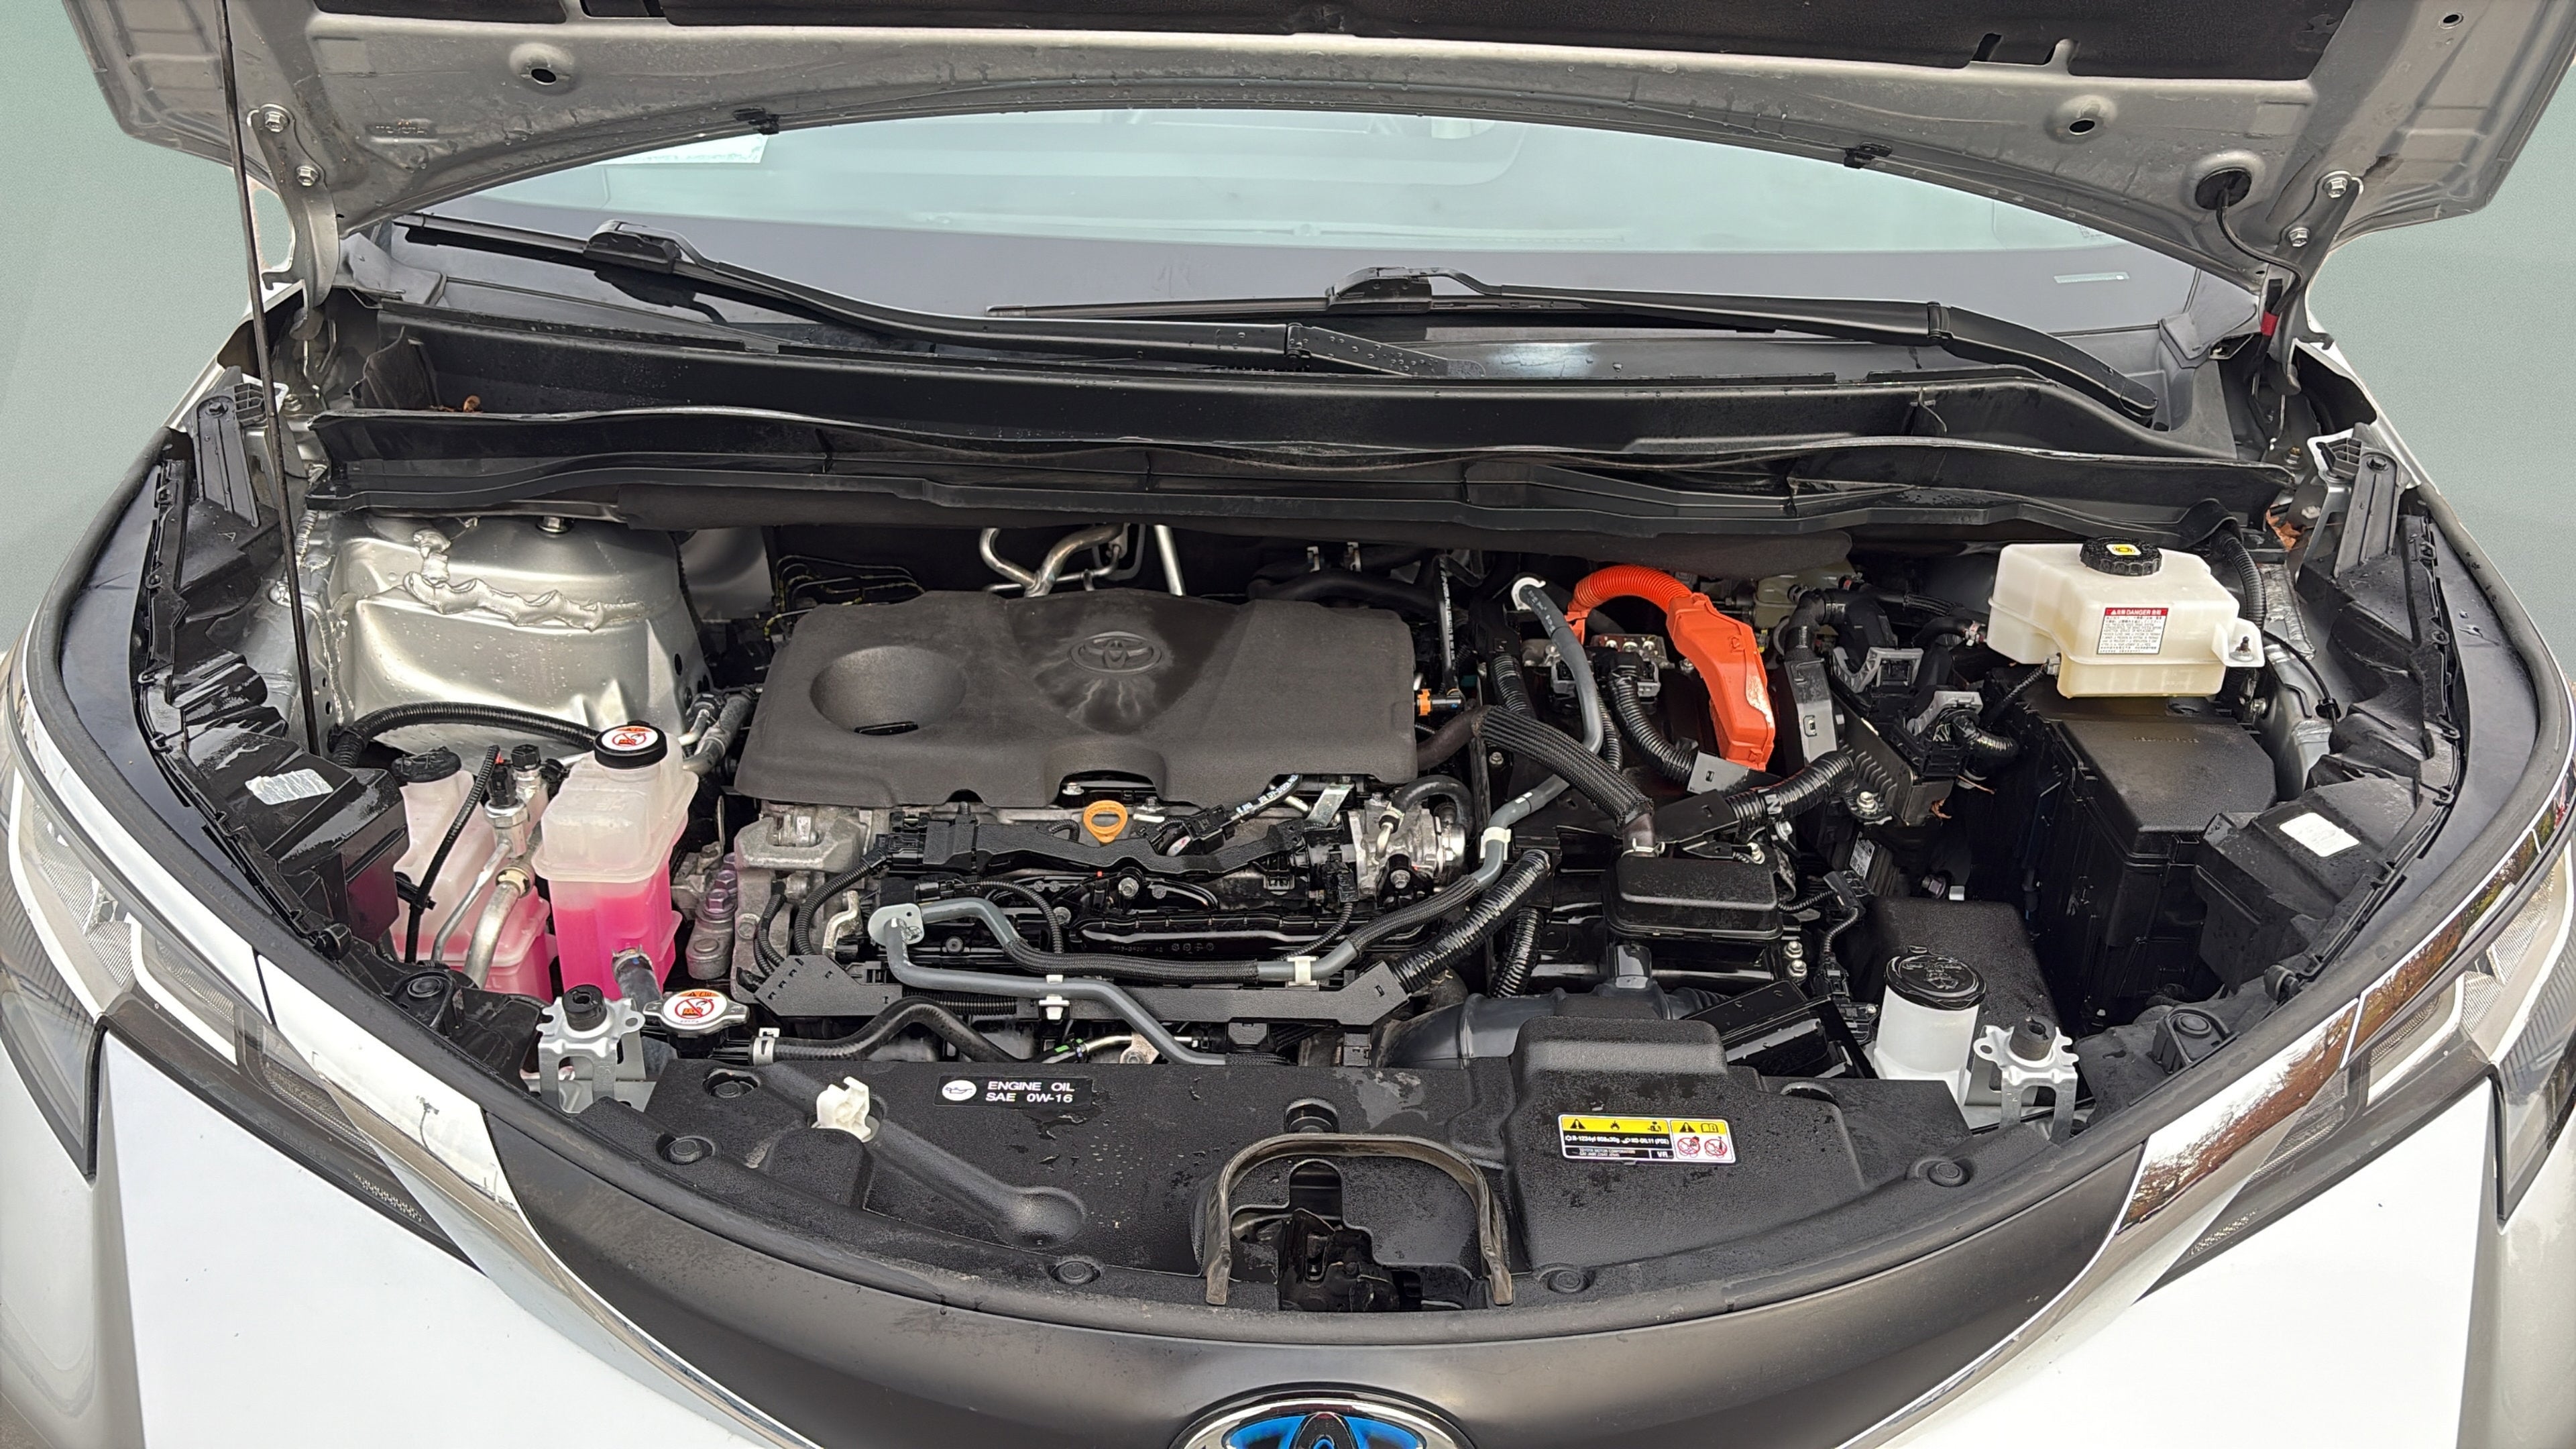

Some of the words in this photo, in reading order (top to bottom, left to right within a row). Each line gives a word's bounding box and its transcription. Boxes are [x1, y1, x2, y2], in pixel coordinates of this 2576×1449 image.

[987, 1081, 1042, 1091] ENGINE
[1051, 1081, 1075, 1092] OIL
[985, 1092, 1016, 1102] SAE
[1026, 1093, 1073, 1104] 0W-16
